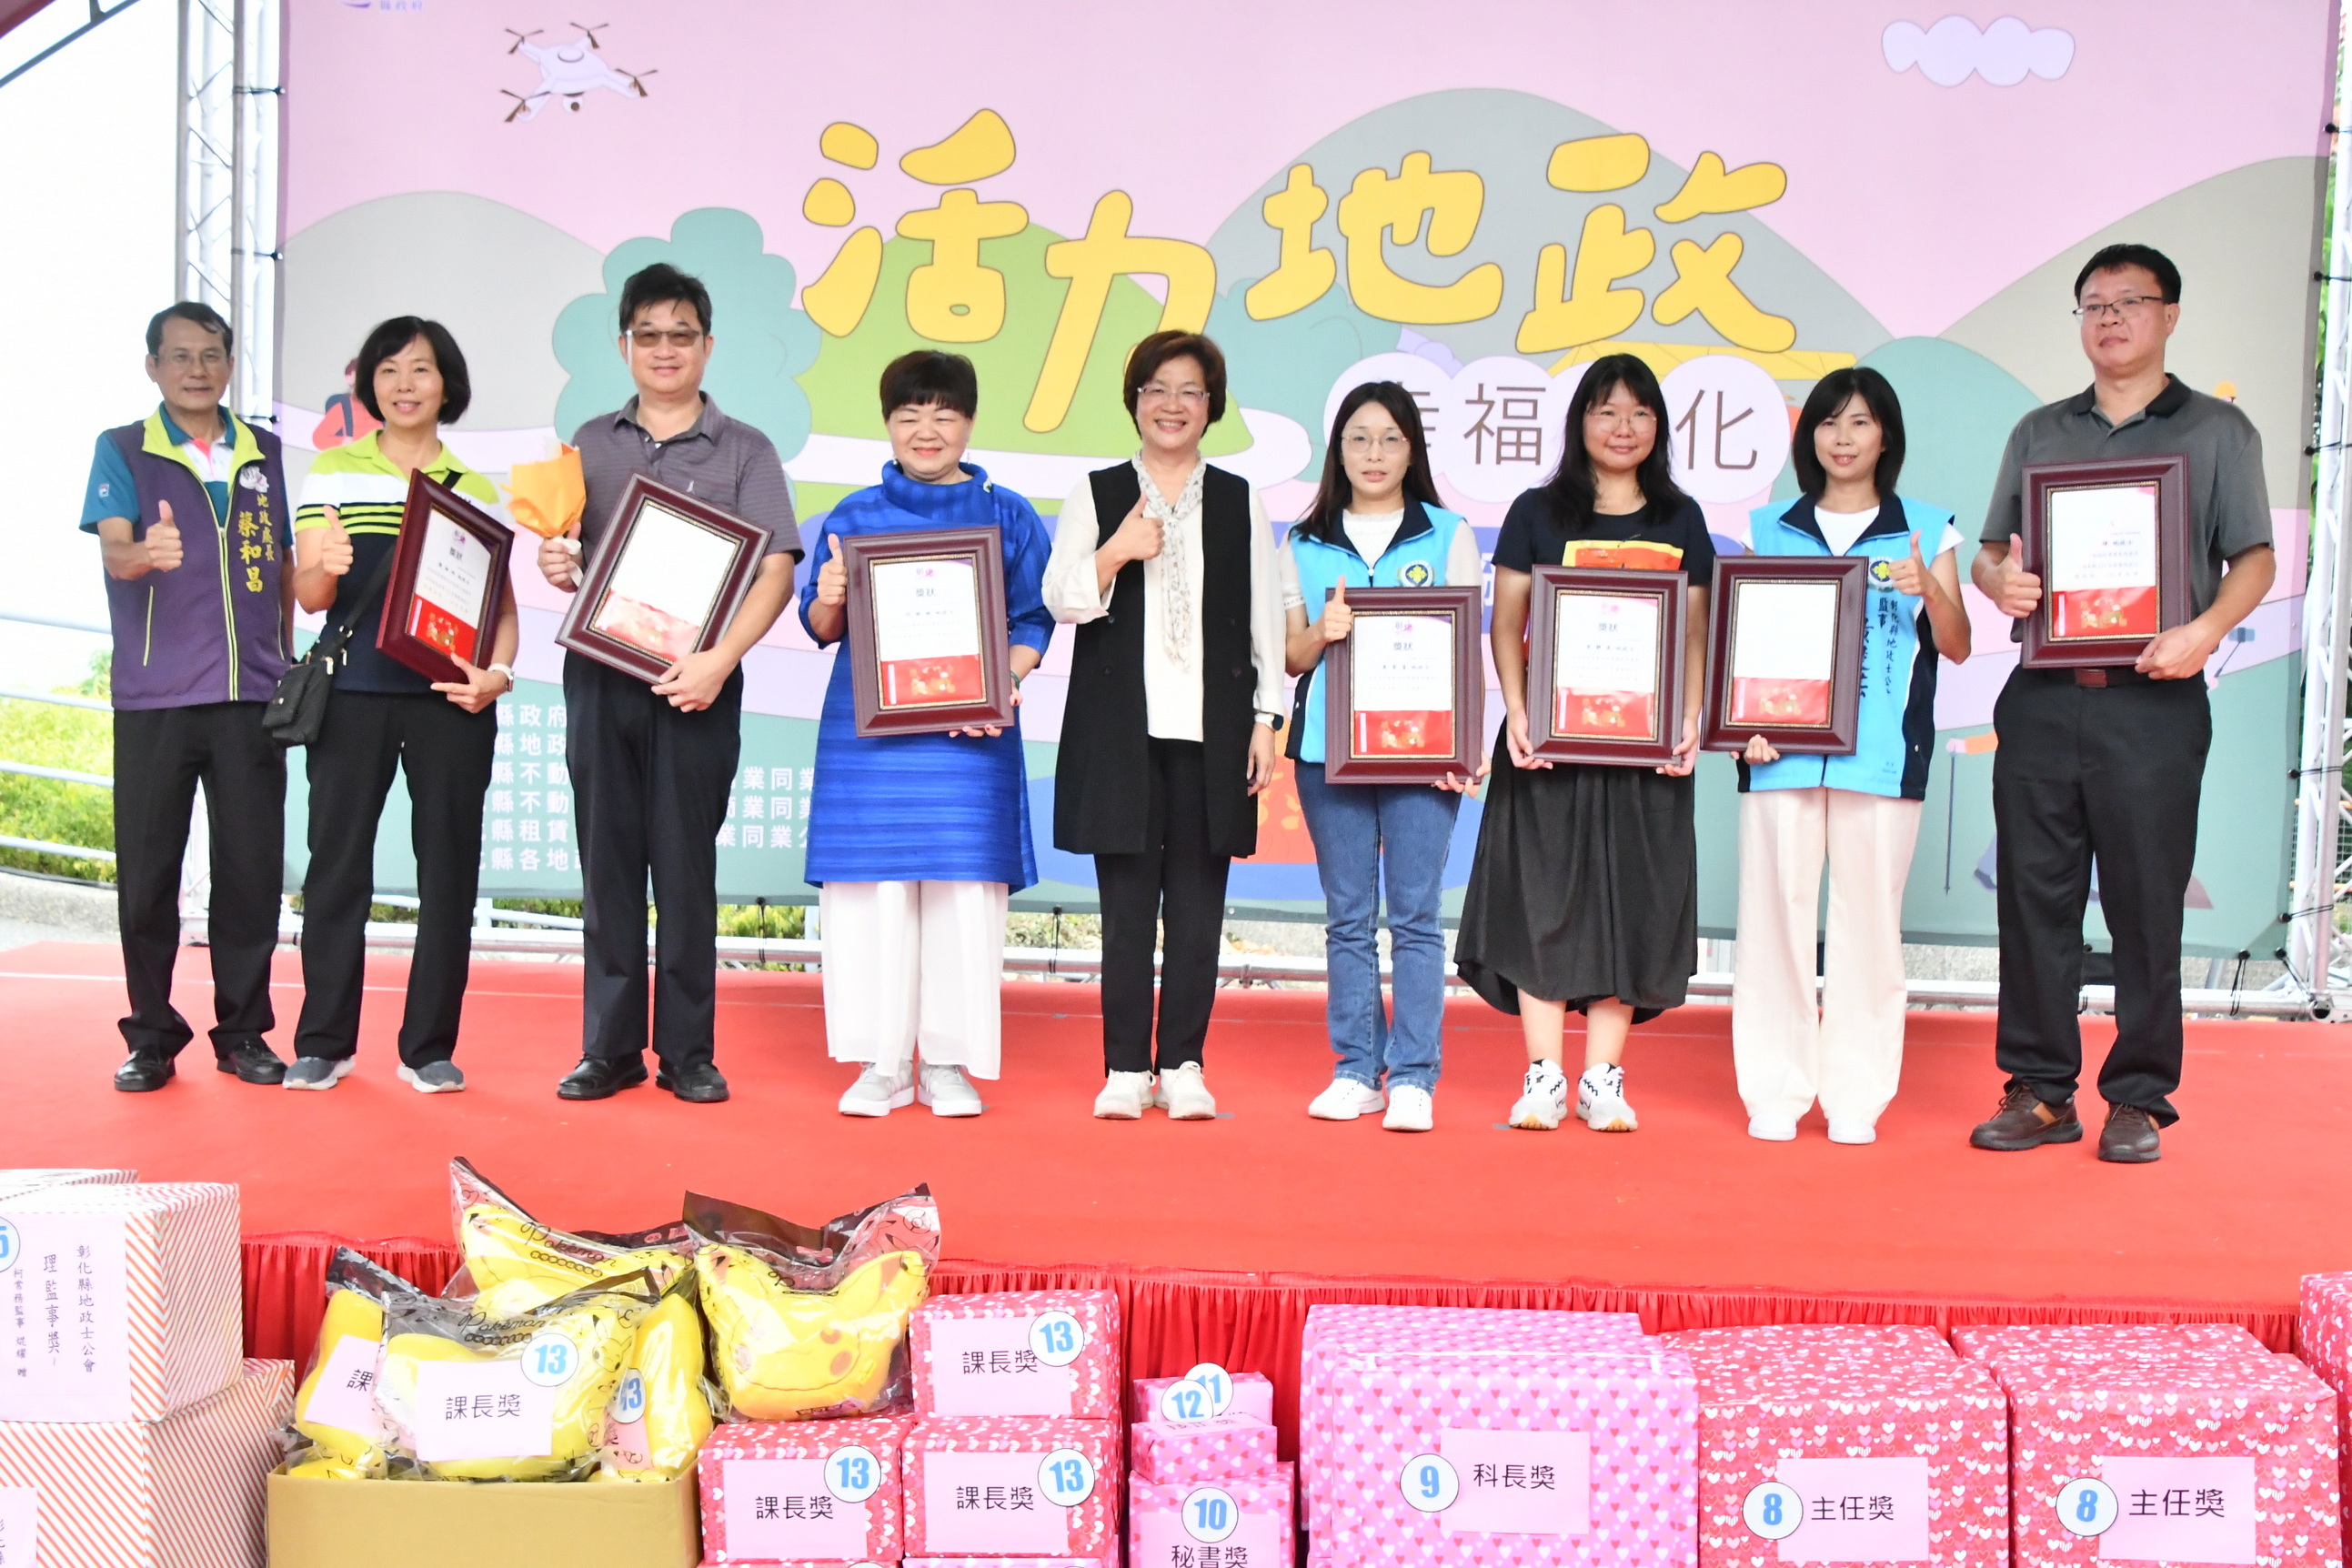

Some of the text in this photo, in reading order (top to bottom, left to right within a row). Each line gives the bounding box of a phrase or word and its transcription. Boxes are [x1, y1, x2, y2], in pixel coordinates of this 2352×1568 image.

[801, 108, 1797, 434] 活力地政
[238, 510, 264, 592] 蔡和昌
[730, 767, 814, 791] 業同業
[483, 789, 569, 814] 縣不動
[481, 819, 568, 842] 縣租賃
[479, 847, 582, 871] 縣各地
[76, 1244, 95, 1372] 彰化縣地政士公會
[1039, 1321, 1074, 1353] 13
[535, 1344, 568, 1374] 13
[962, 1349, 1039, 1374] 課長獎
[445, 1393, 521, 1421] 課長獎
[1171, 1390, 1205, 1419] 12
[836, 1457, 870, 1490] 13
[1049, 1459, 1085, 1493] 13
[1420, 1465, 1440, 1498] 9
[1473, 1463, 1555, 1490] 科長獎
[756, 1495, 834, 1521] 課長獎
[956, 1485, 1035, 1511] 課長獎
[1763, 1493, 1783, 1525] 8
[1811, 1496, 1895, 1521] 主任獎
[2076, 1489, 2098, 1522] 8
[2129, 1489, 2225, 1518] 主任獎
[1194, 1498, 1228, 1530] 10
[1171, 1545, 1248, 1568] 秘書獎
